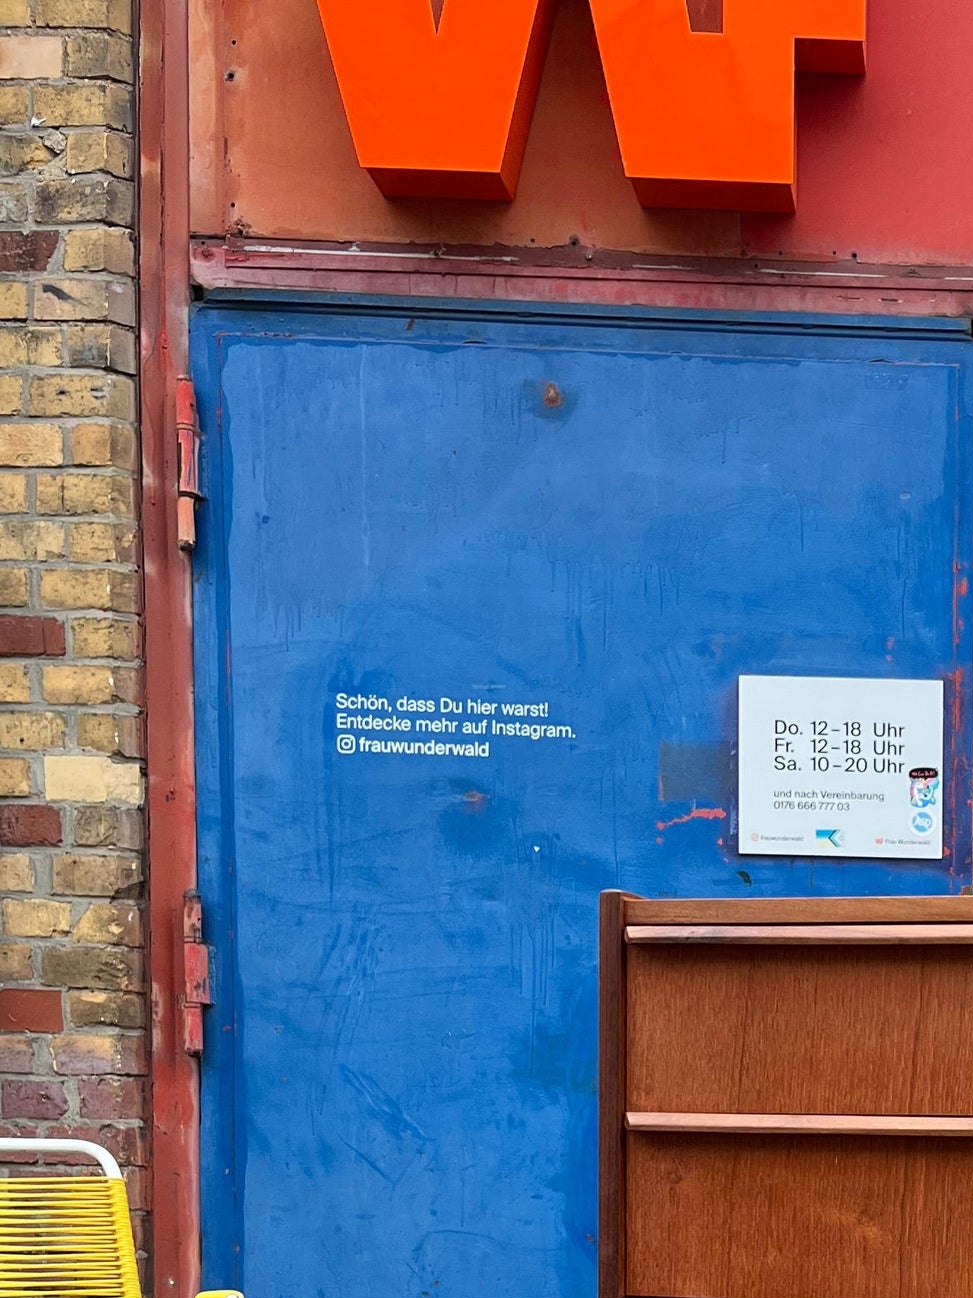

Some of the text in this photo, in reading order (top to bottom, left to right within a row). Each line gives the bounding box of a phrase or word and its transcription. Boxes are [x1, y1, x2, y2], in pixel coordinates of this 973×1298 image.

[336, 692, 549, 717] Schön, dass Du hier warst!
[336, 713, 576, 740] Entdecke mehr auf Instagram.
[774, 719, 803, 735] Do.
[873, 722, 905, 738] Uhr
[359, 736, 489, 758] frauwunderwald
[774, 737, 795, 753] Fr.
[873, 740, 905, 756] Uhr
[774, 755, 802, 771] Sa.
[873, 758, 905, 774] Uhr
[773, 790, 885, 802] und nach Vereinbarung
[773, 800, 850, 812] 0176 666 777 03
